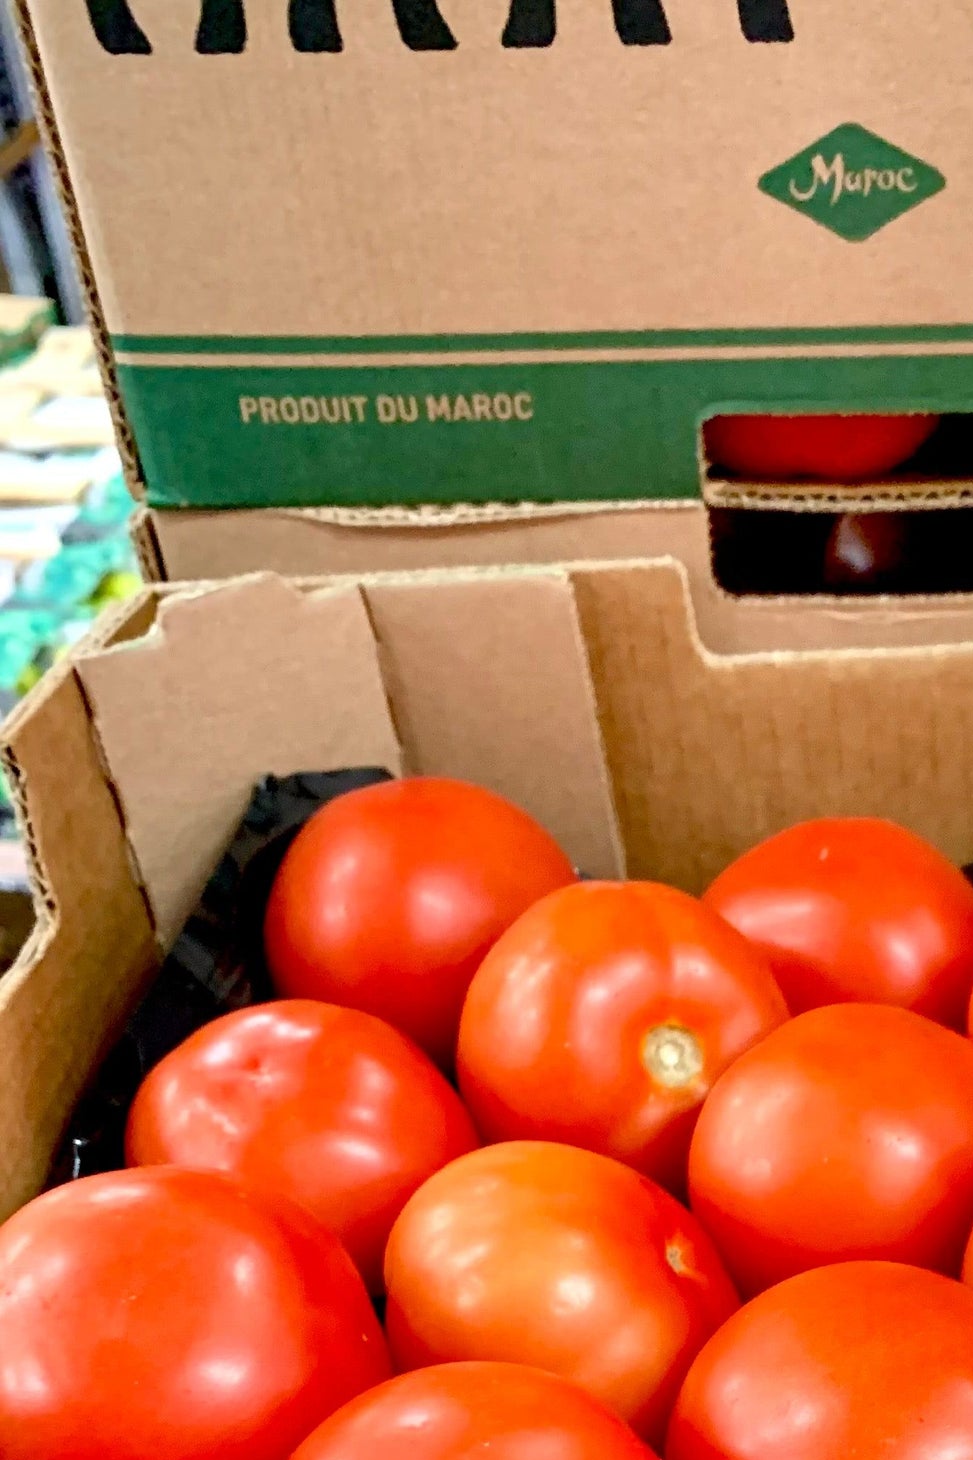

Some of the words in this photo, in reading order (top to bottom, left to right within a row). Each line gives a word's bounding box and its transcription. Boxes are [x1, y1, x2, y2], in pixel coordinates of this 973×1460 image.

[789, 152, 918, 207] Maroc
[238, 394, 368, 424] PRODUIT
[375, 394, 420, 424] DU
[426, 391, 534, 422] MAROC
